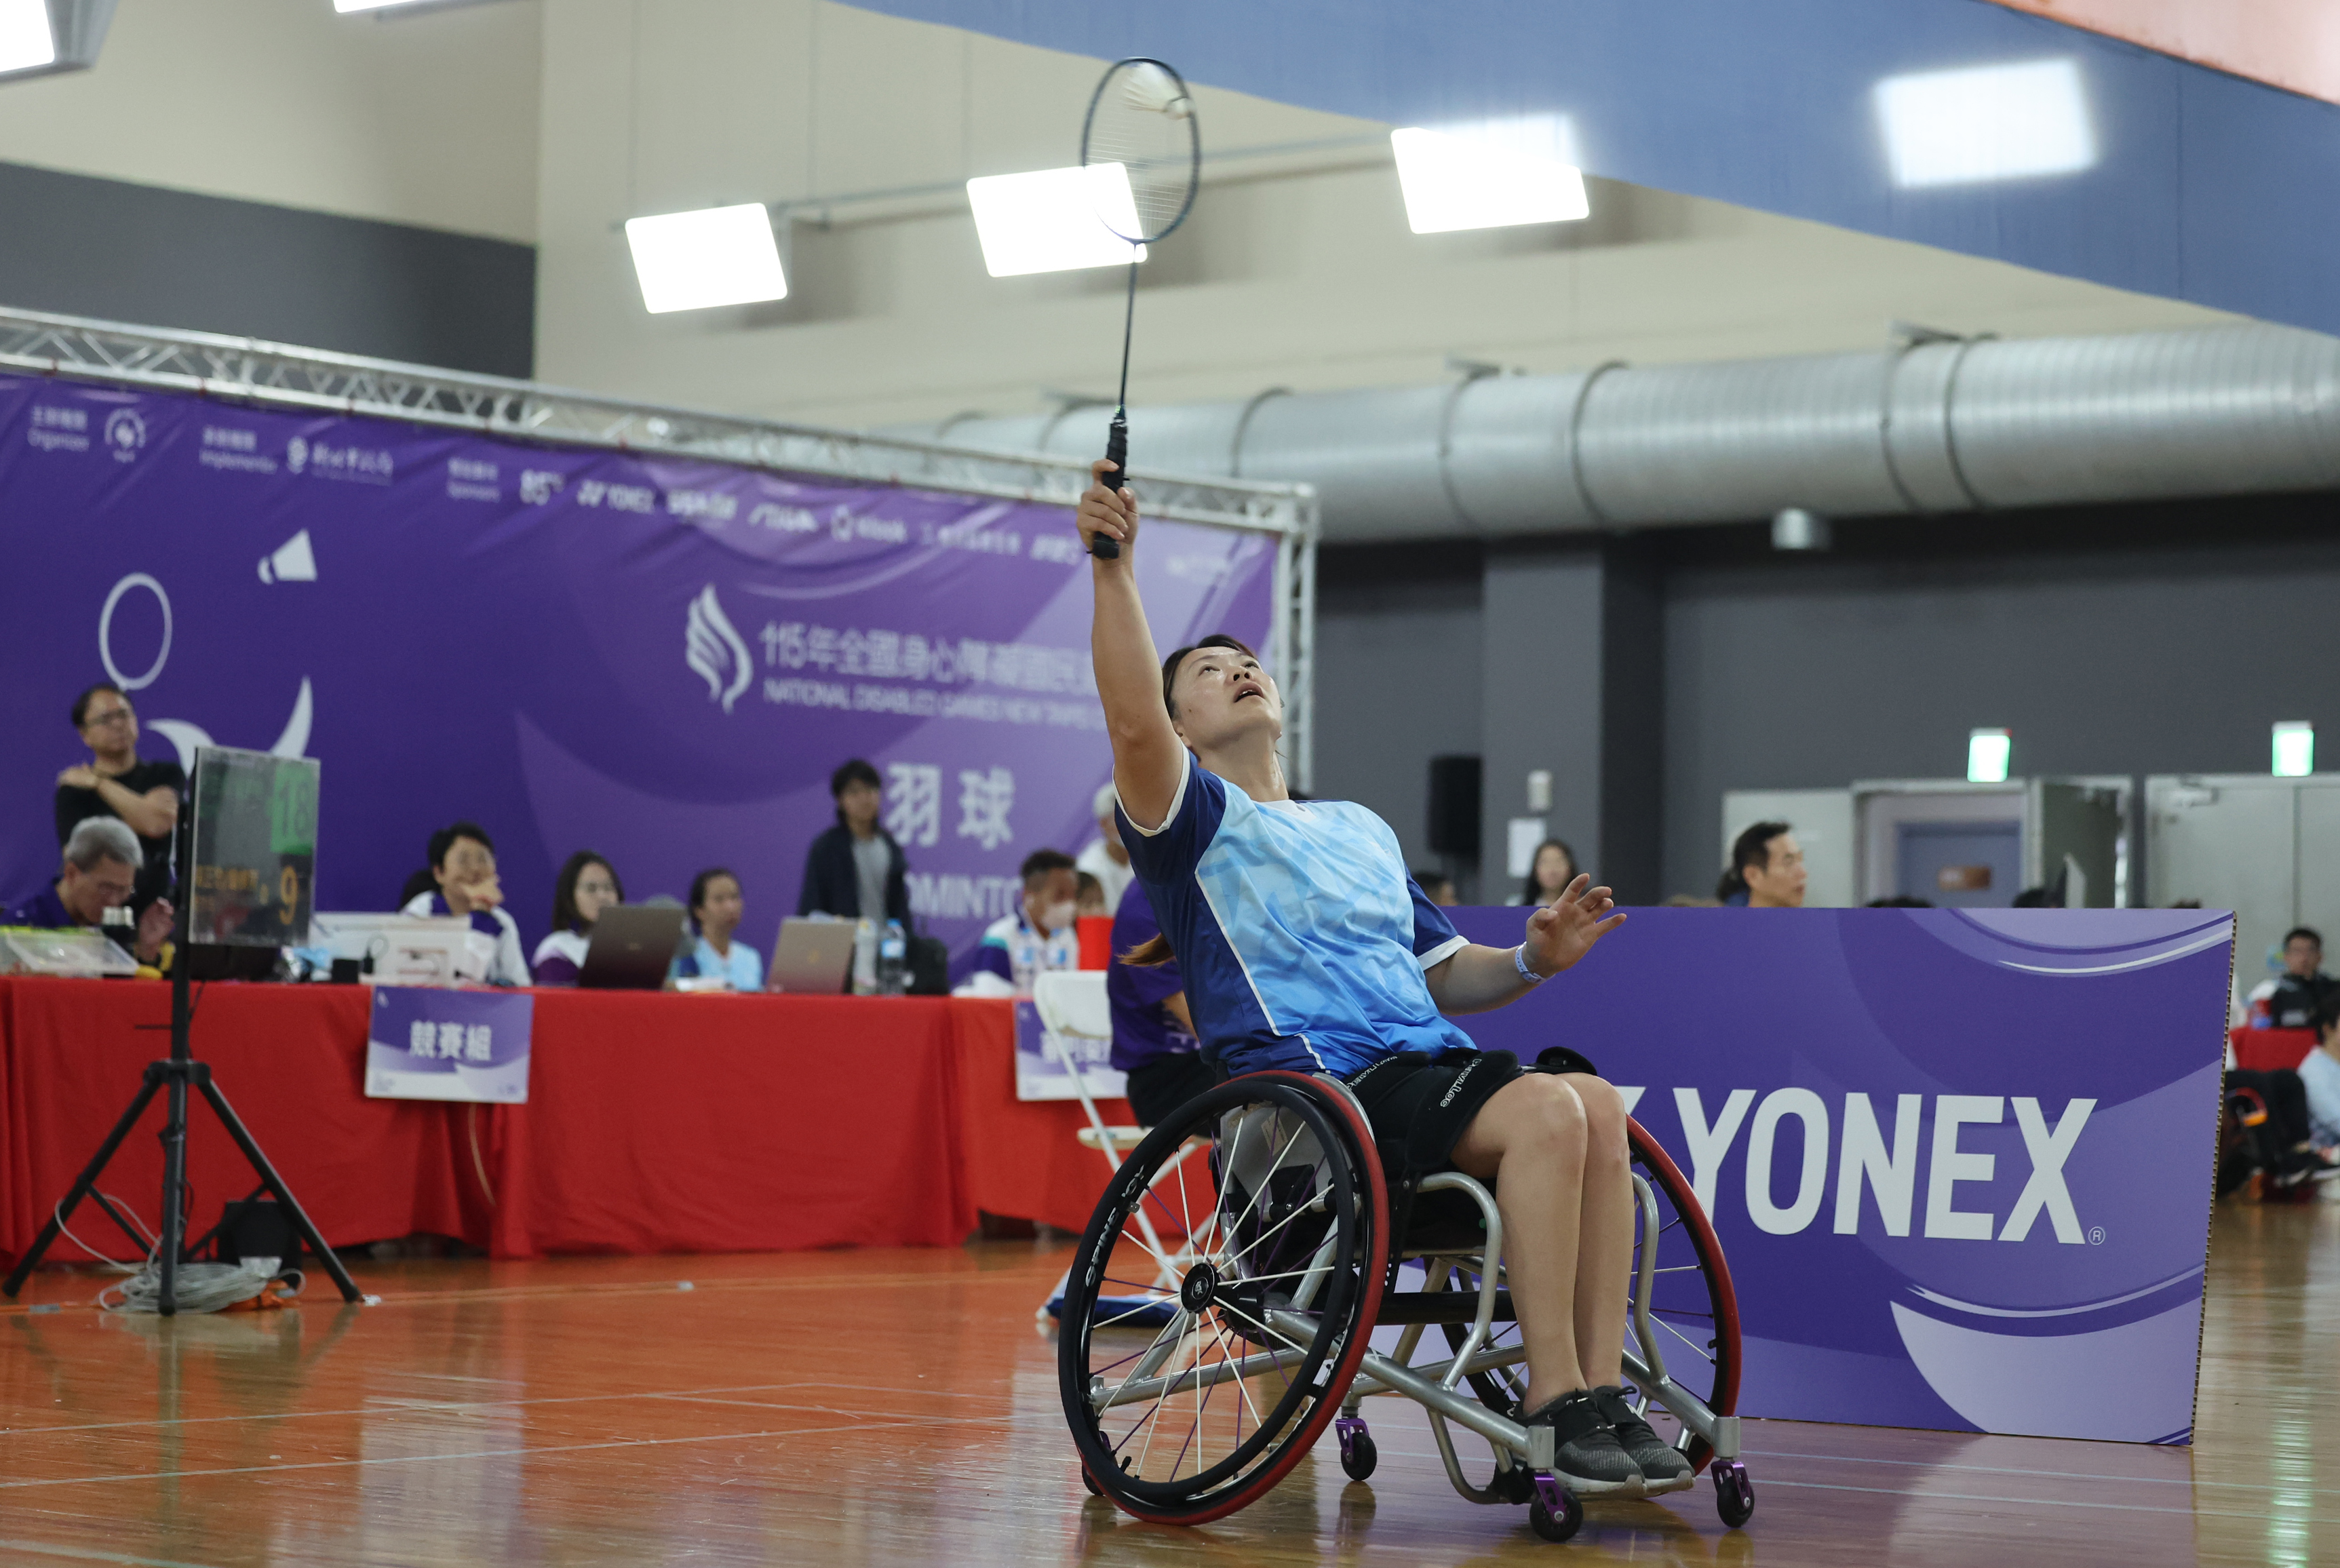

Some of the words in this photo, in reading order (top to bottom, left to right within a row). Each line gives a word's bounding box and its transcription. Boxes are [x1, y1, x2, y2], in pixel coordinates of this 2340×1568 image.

[886, 762, 1015, 850] 羽球
[279, 865, 298, 925] 9
[1673, 1087, 2098, 1244] YONEX
[1085, 1164, 1145, 1287] SPINEGY
